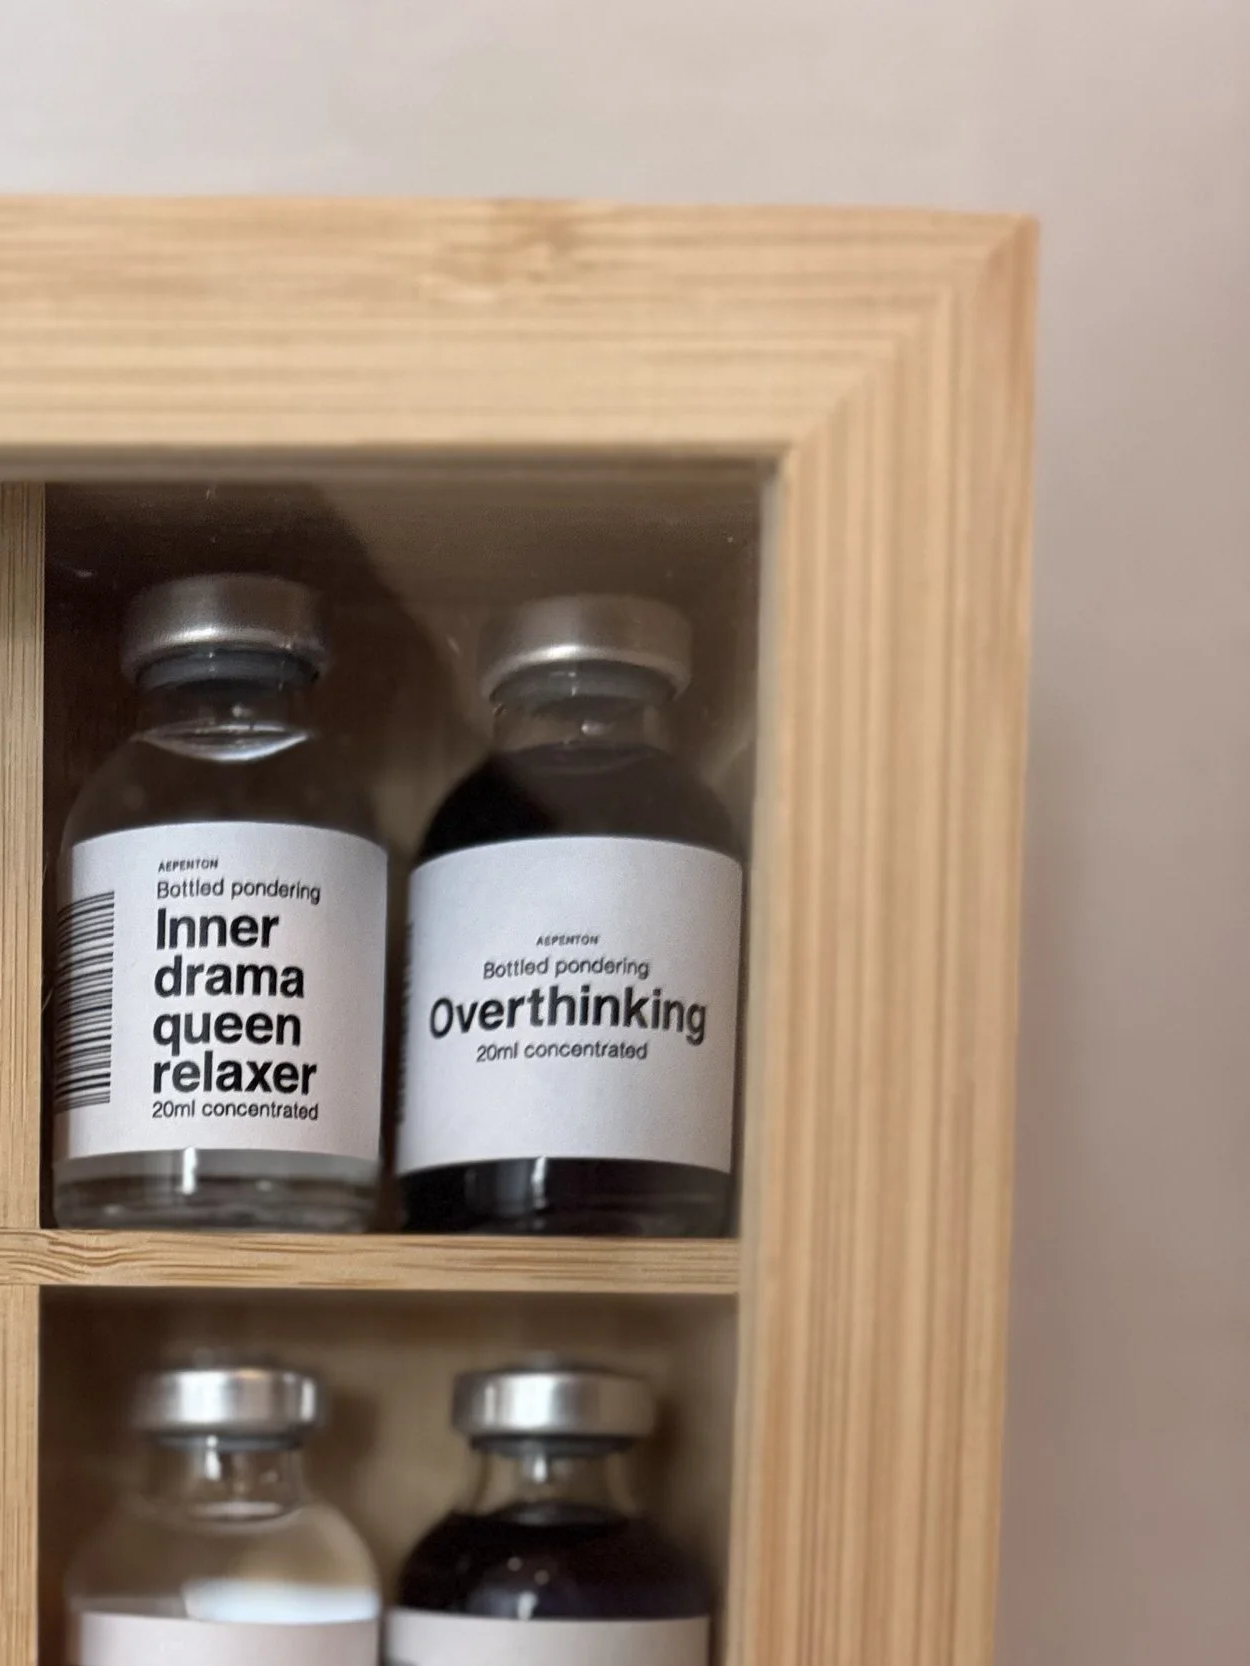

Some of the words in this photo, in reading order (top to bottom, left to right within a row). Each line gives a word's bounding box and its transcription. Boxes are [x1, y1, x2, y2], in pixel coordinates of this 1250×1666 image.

[158, 858, 219, 872] AEPENTON
[156, 878, 225, 900] Bottled
[231, 879, 321, 905] pondering
[156, 907, 279, 950] Inner
[154, 954, 305, 999] drama
[483, 957, 549, 980] Bottled
[554, 957, 650, 980] pondering
[429, 984, 707, 1046] Overthinking
[152, 1011, 301, 1056] queen
[476, 1041, 519, 1063] 20ml
[523, 1040, 648, 1061] concentrated
[152, 1050, 317, 1095] relaxer
[152, 1100, 196, 1119] 20ml
[201, 1100, 319, 1121] concentrated
